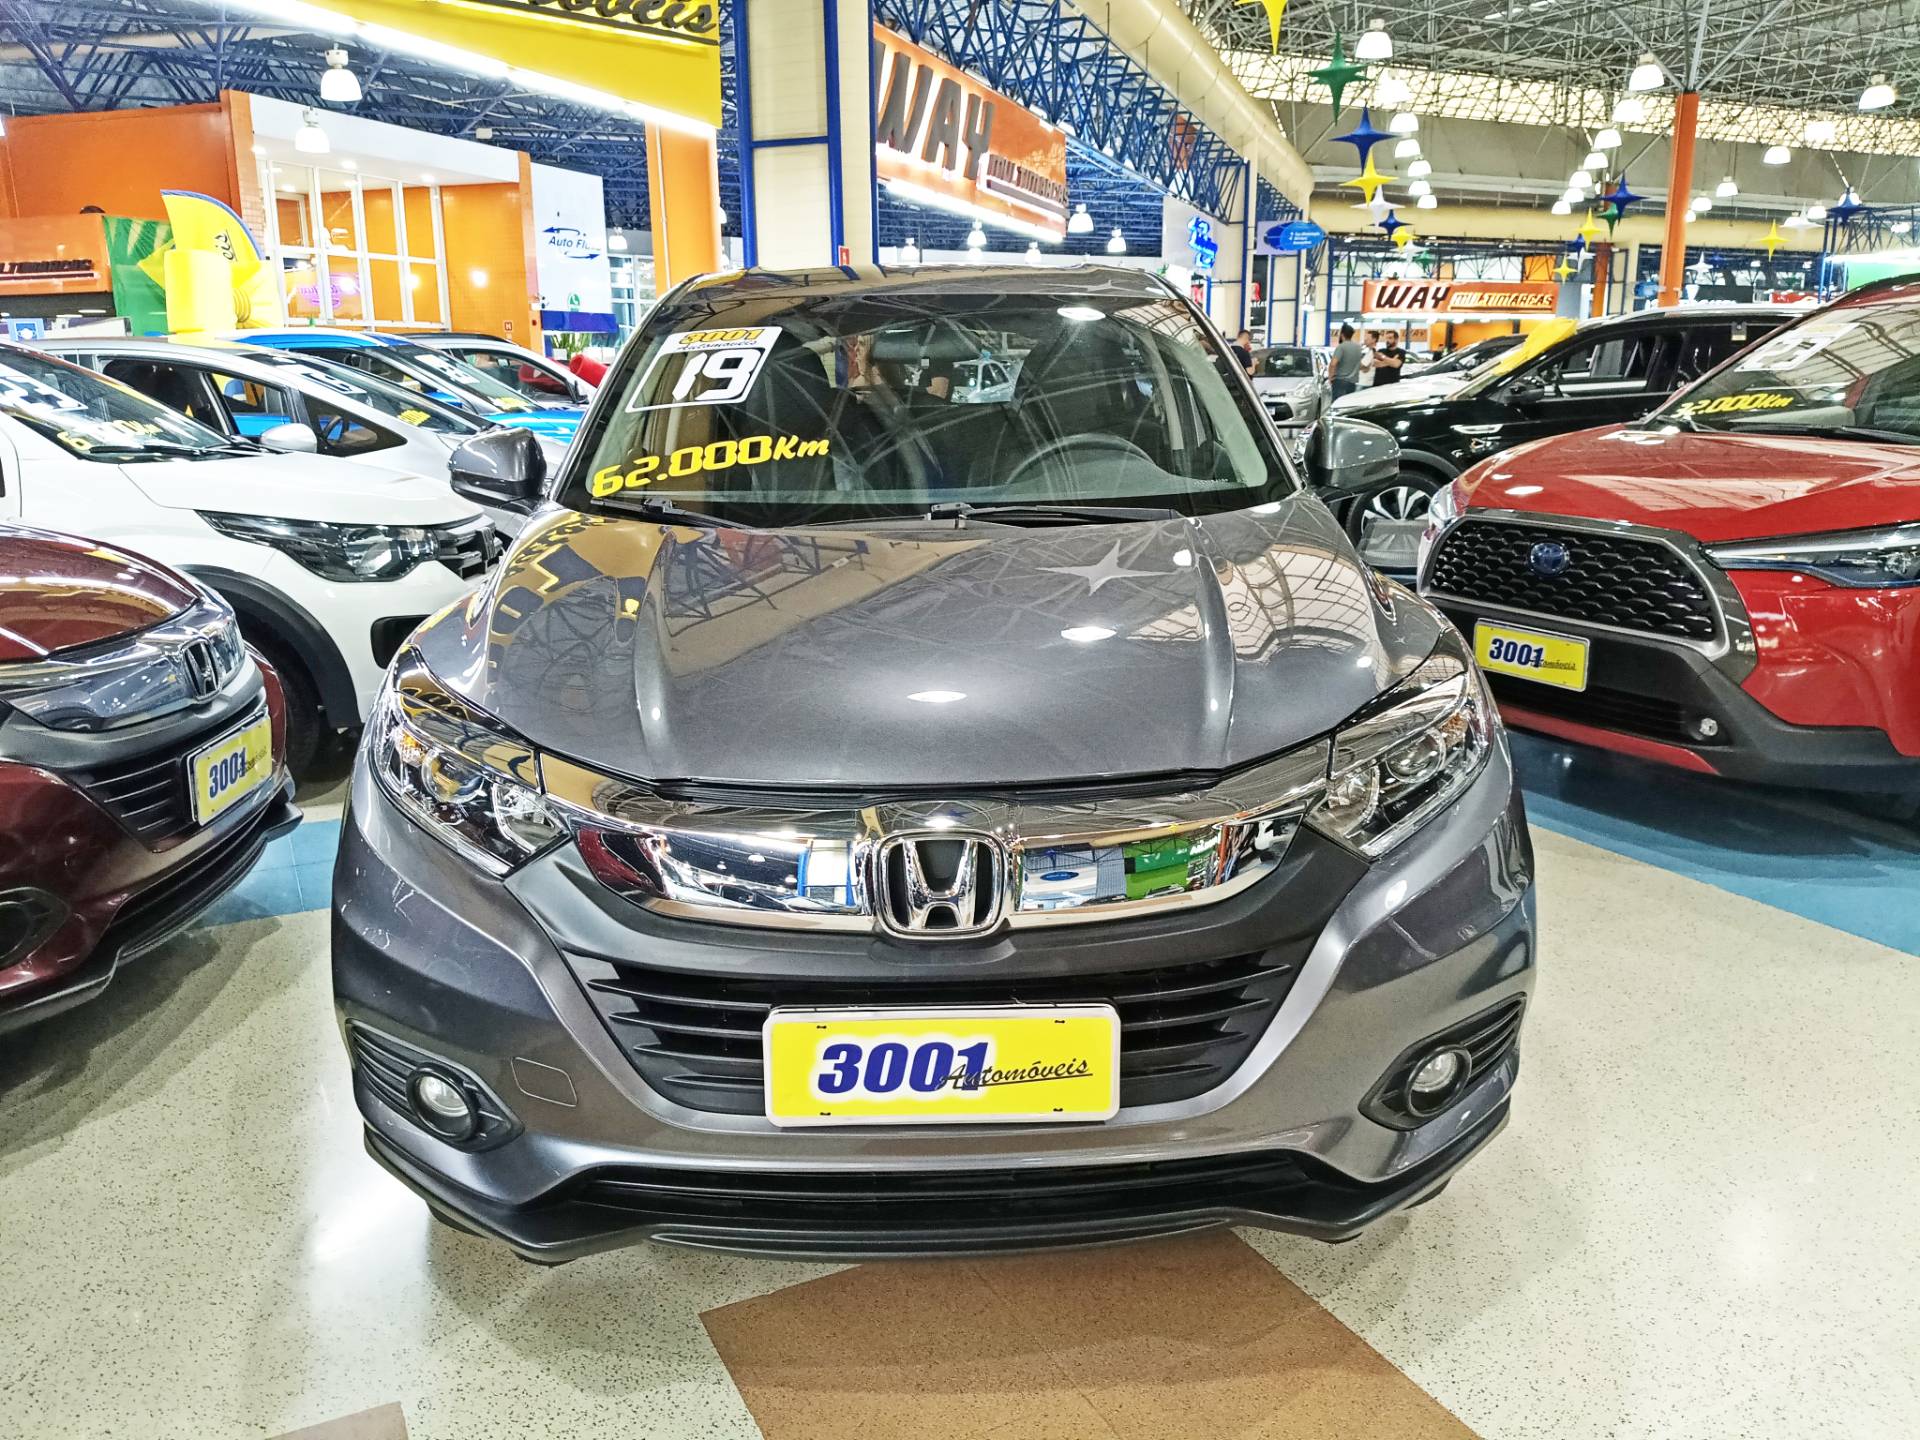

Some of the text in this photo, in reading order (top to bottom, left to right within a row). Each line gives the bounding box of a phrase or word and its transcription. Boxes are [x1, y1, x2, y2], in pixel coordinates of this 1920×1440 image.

[874, 39, 995, 180] WAY
[548, 236, 573, 248] Auto
[1375, 286, 1451, 309] WAY
[679, 329, 765, 345] 3001
[672, 349, 763, 401] 19
[592, 435, 829, 497] 62.000Km
[1489, 638, 1544, 668] 3001
[209, 747, 246, 798] 3001
[817, 1041, 1092, 1094] 3001 Automóveis
